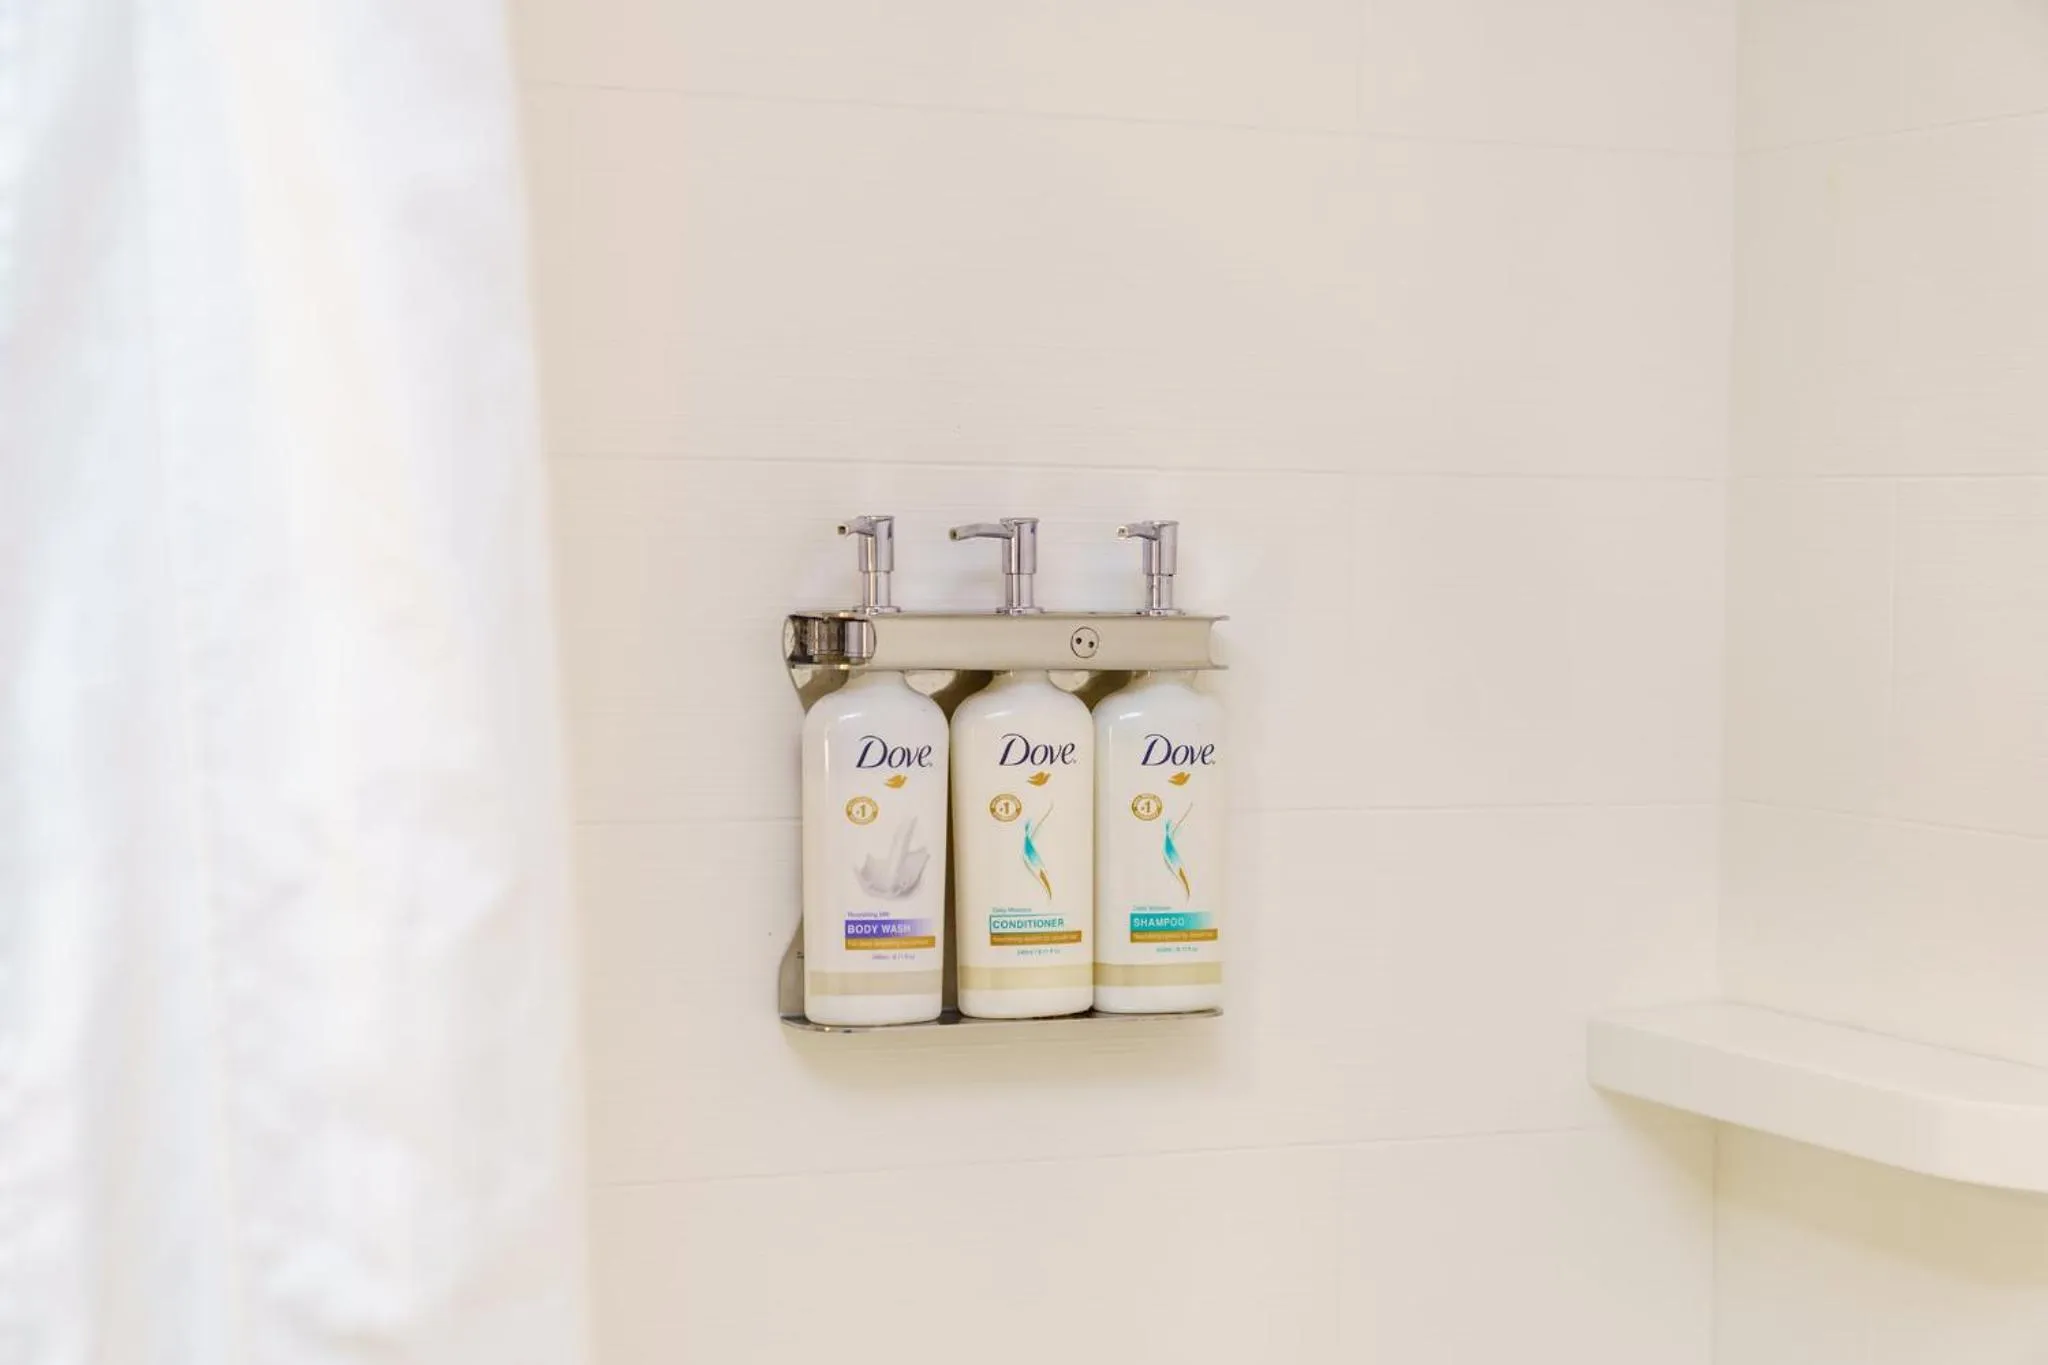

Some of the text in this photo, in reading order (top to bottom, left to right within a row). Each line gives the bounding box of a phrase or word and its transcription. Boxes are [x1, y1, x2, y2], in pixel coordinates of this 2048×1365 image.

[856, 735, 933, 768] Dove
[999, 733, 1077, 766] Dove
[1141, 733, 1216, 766] Dove
[847, 924, 912, 935] BODY WASH
[992, 918, 1064, 929] CONDITIONER
[1133, 917, 1185, 928] SHAMPOO
